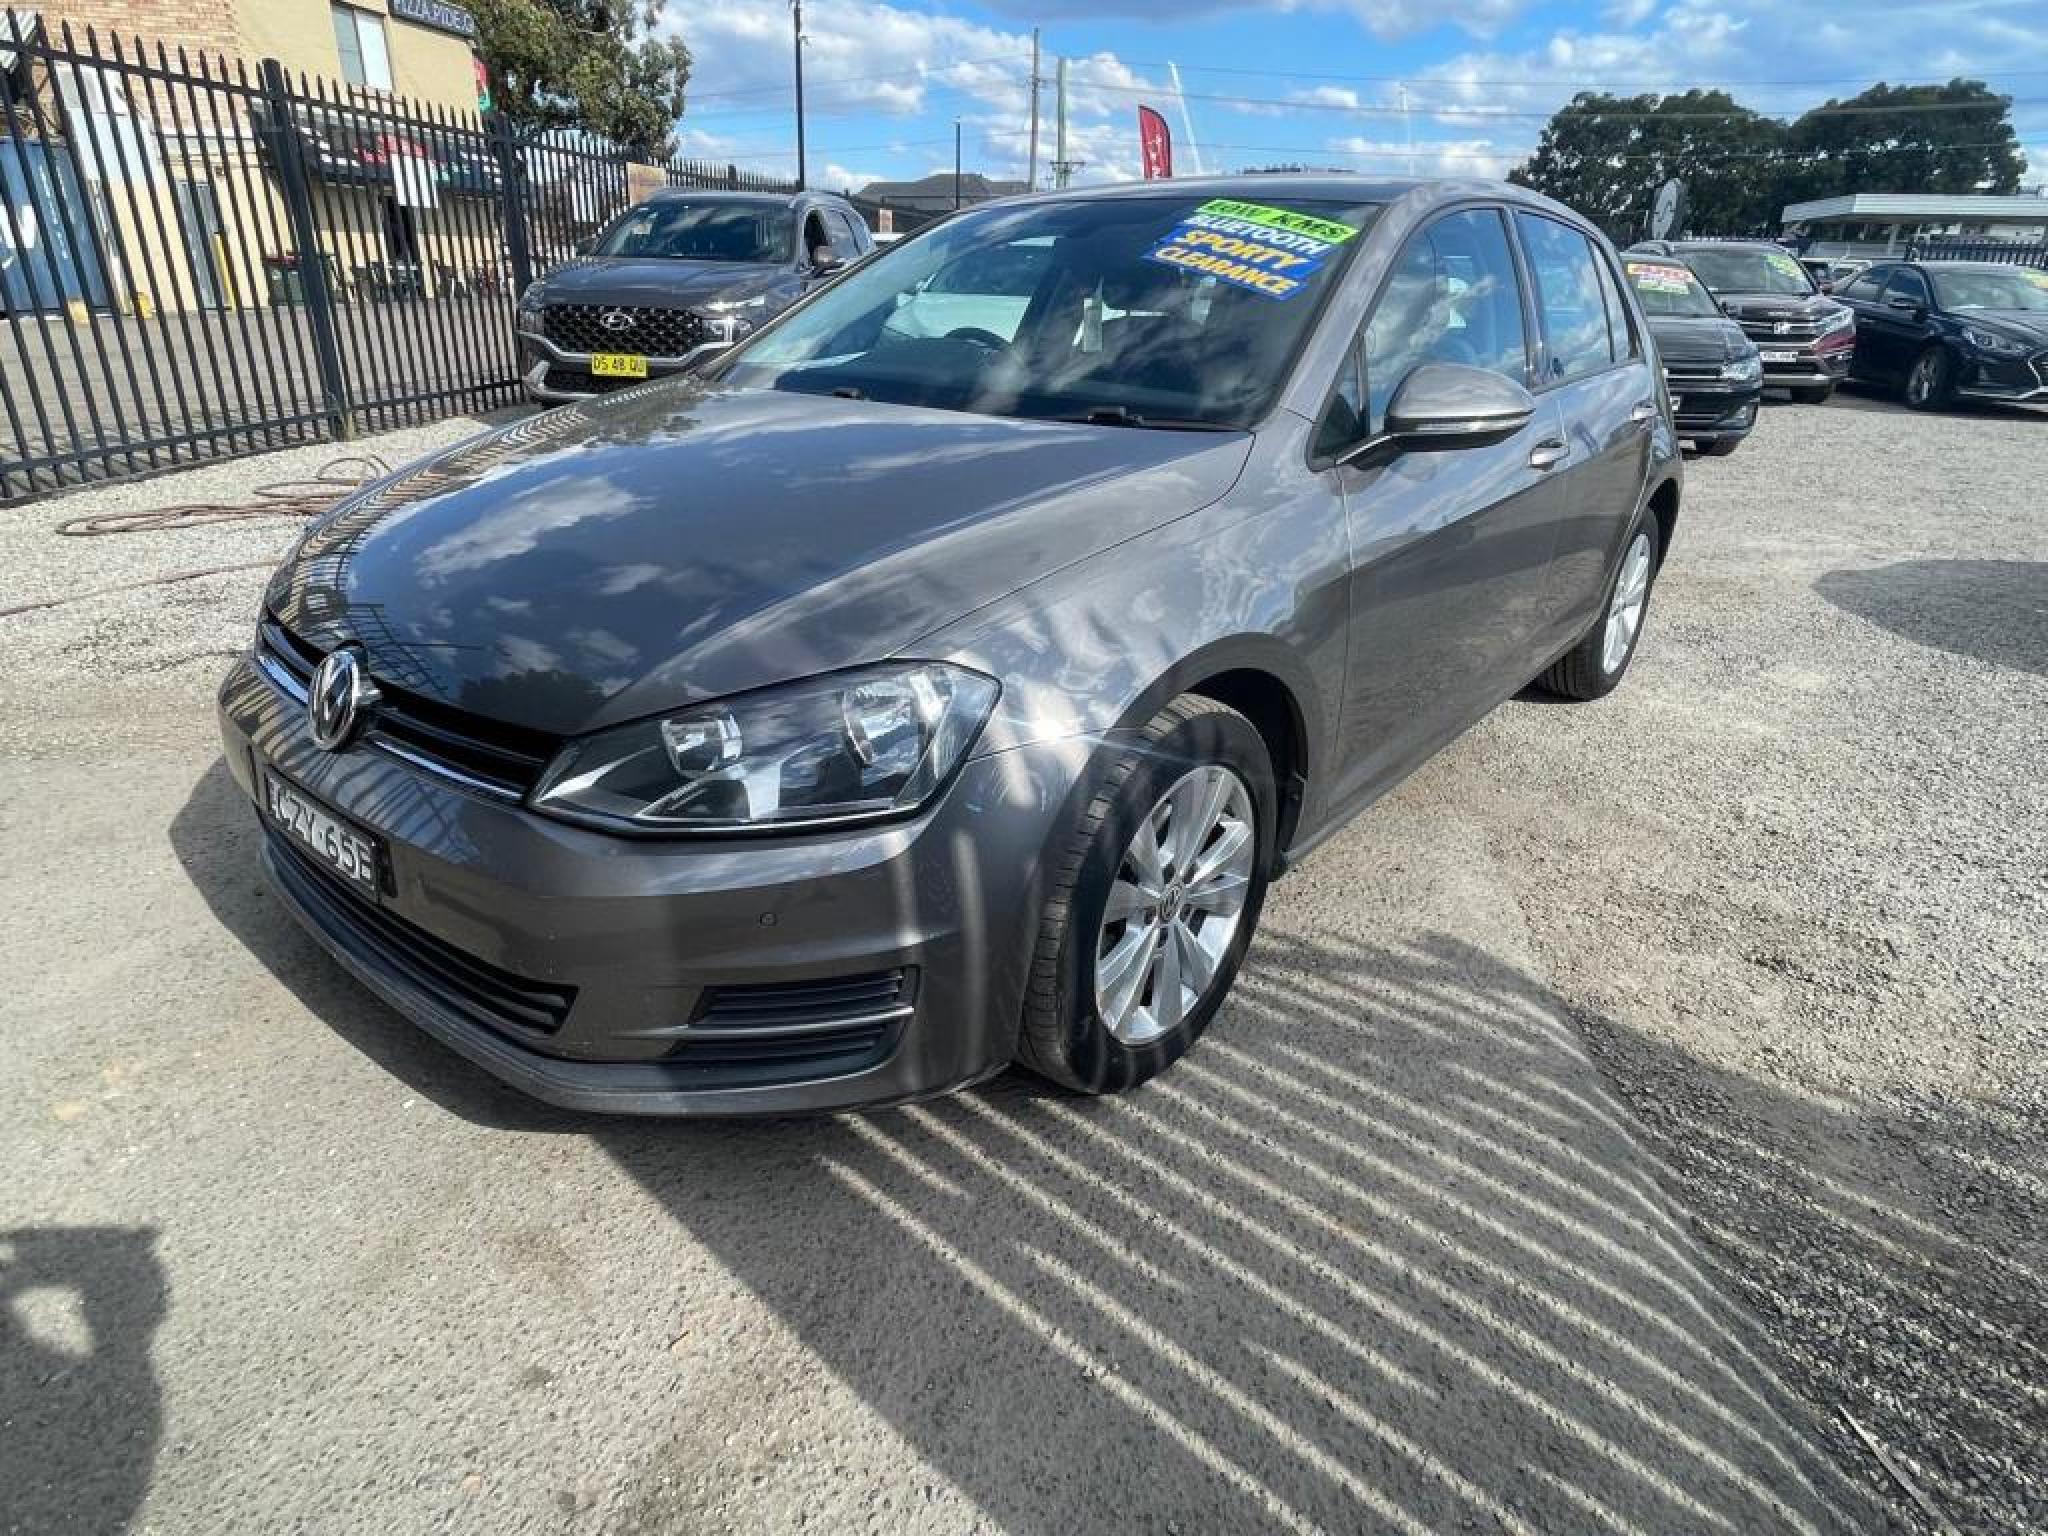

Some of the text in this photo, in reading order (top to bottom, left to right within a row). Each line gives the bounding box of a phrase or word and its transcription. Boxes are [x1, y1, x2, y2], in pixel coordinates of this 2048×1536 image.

[1175, 230, 1311, 269] SPORTY
[1184, 215, 1332, 254] BLUETOOTH
[1155, 247, 1299, 294] CLEARANCE
